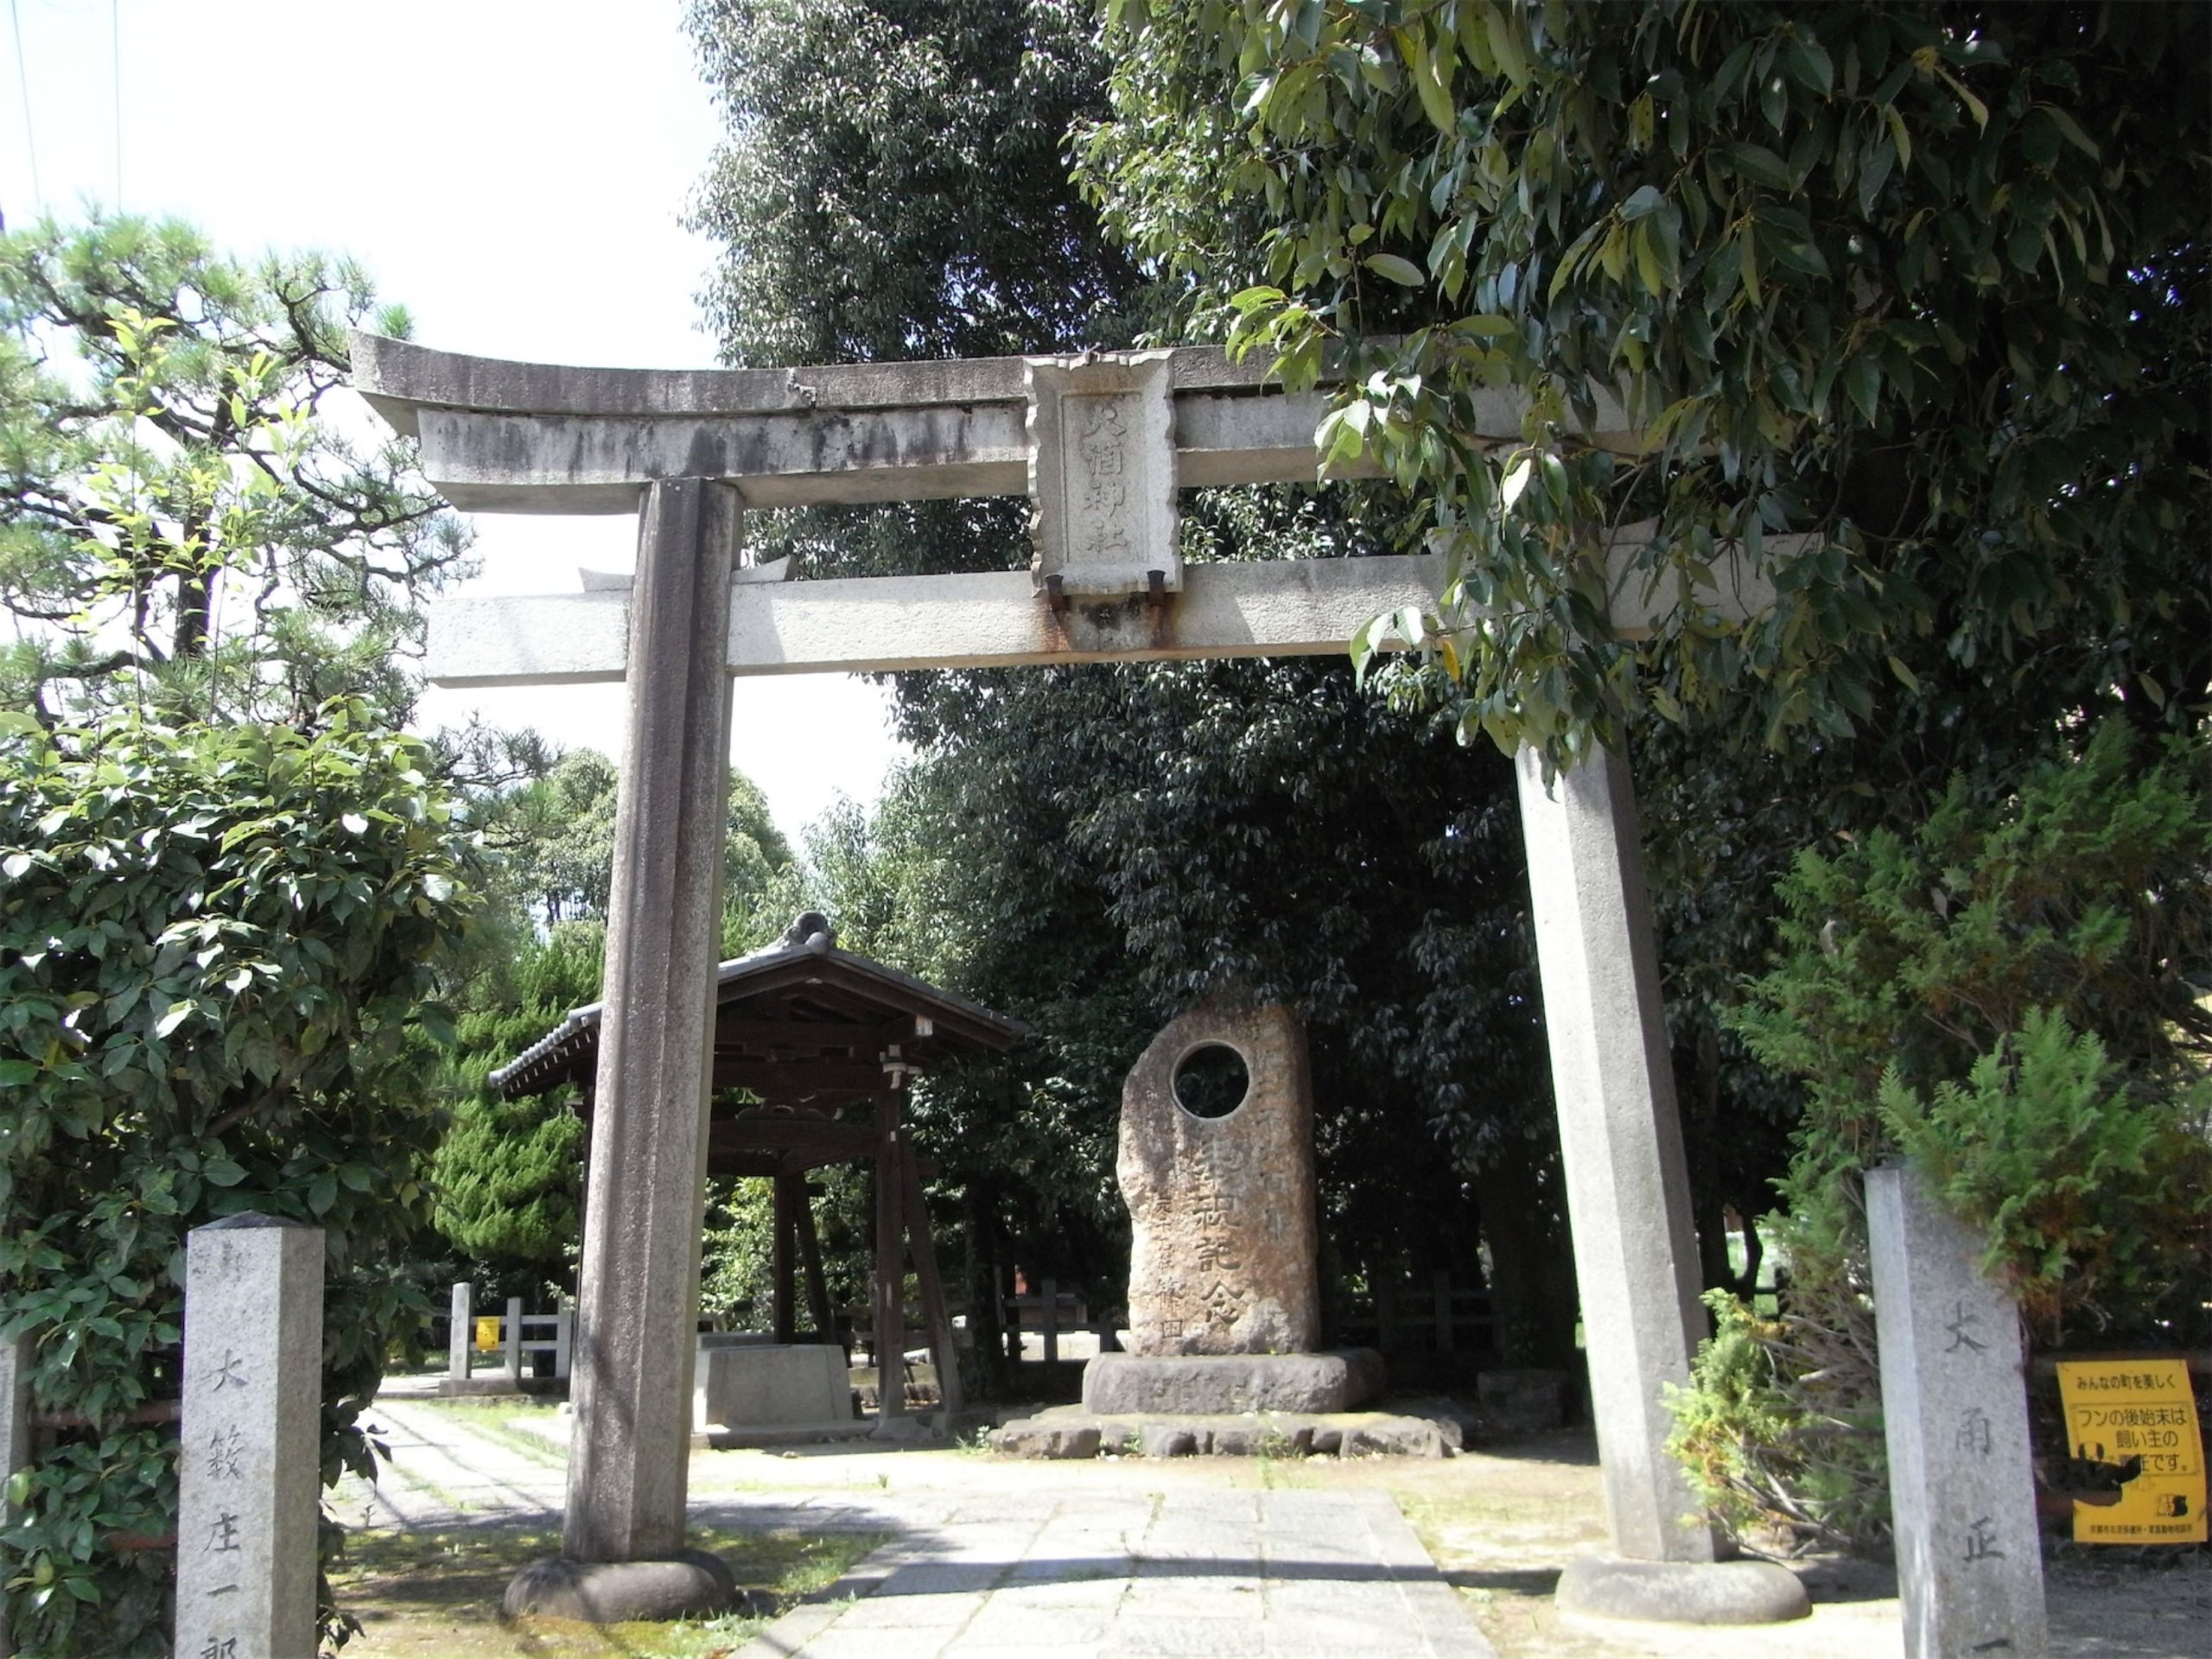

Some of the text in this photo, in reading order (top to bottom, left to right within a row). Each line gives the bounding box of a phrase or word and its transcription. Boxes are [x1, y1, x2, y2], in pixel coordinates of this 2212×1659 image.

[2076, 1373, 2177, 1391] みんなの町を美しく
[2077, 1407, 2188, 1428] フンの後始末は
[2115, 1429, 2180, 1449] 飼い主の
